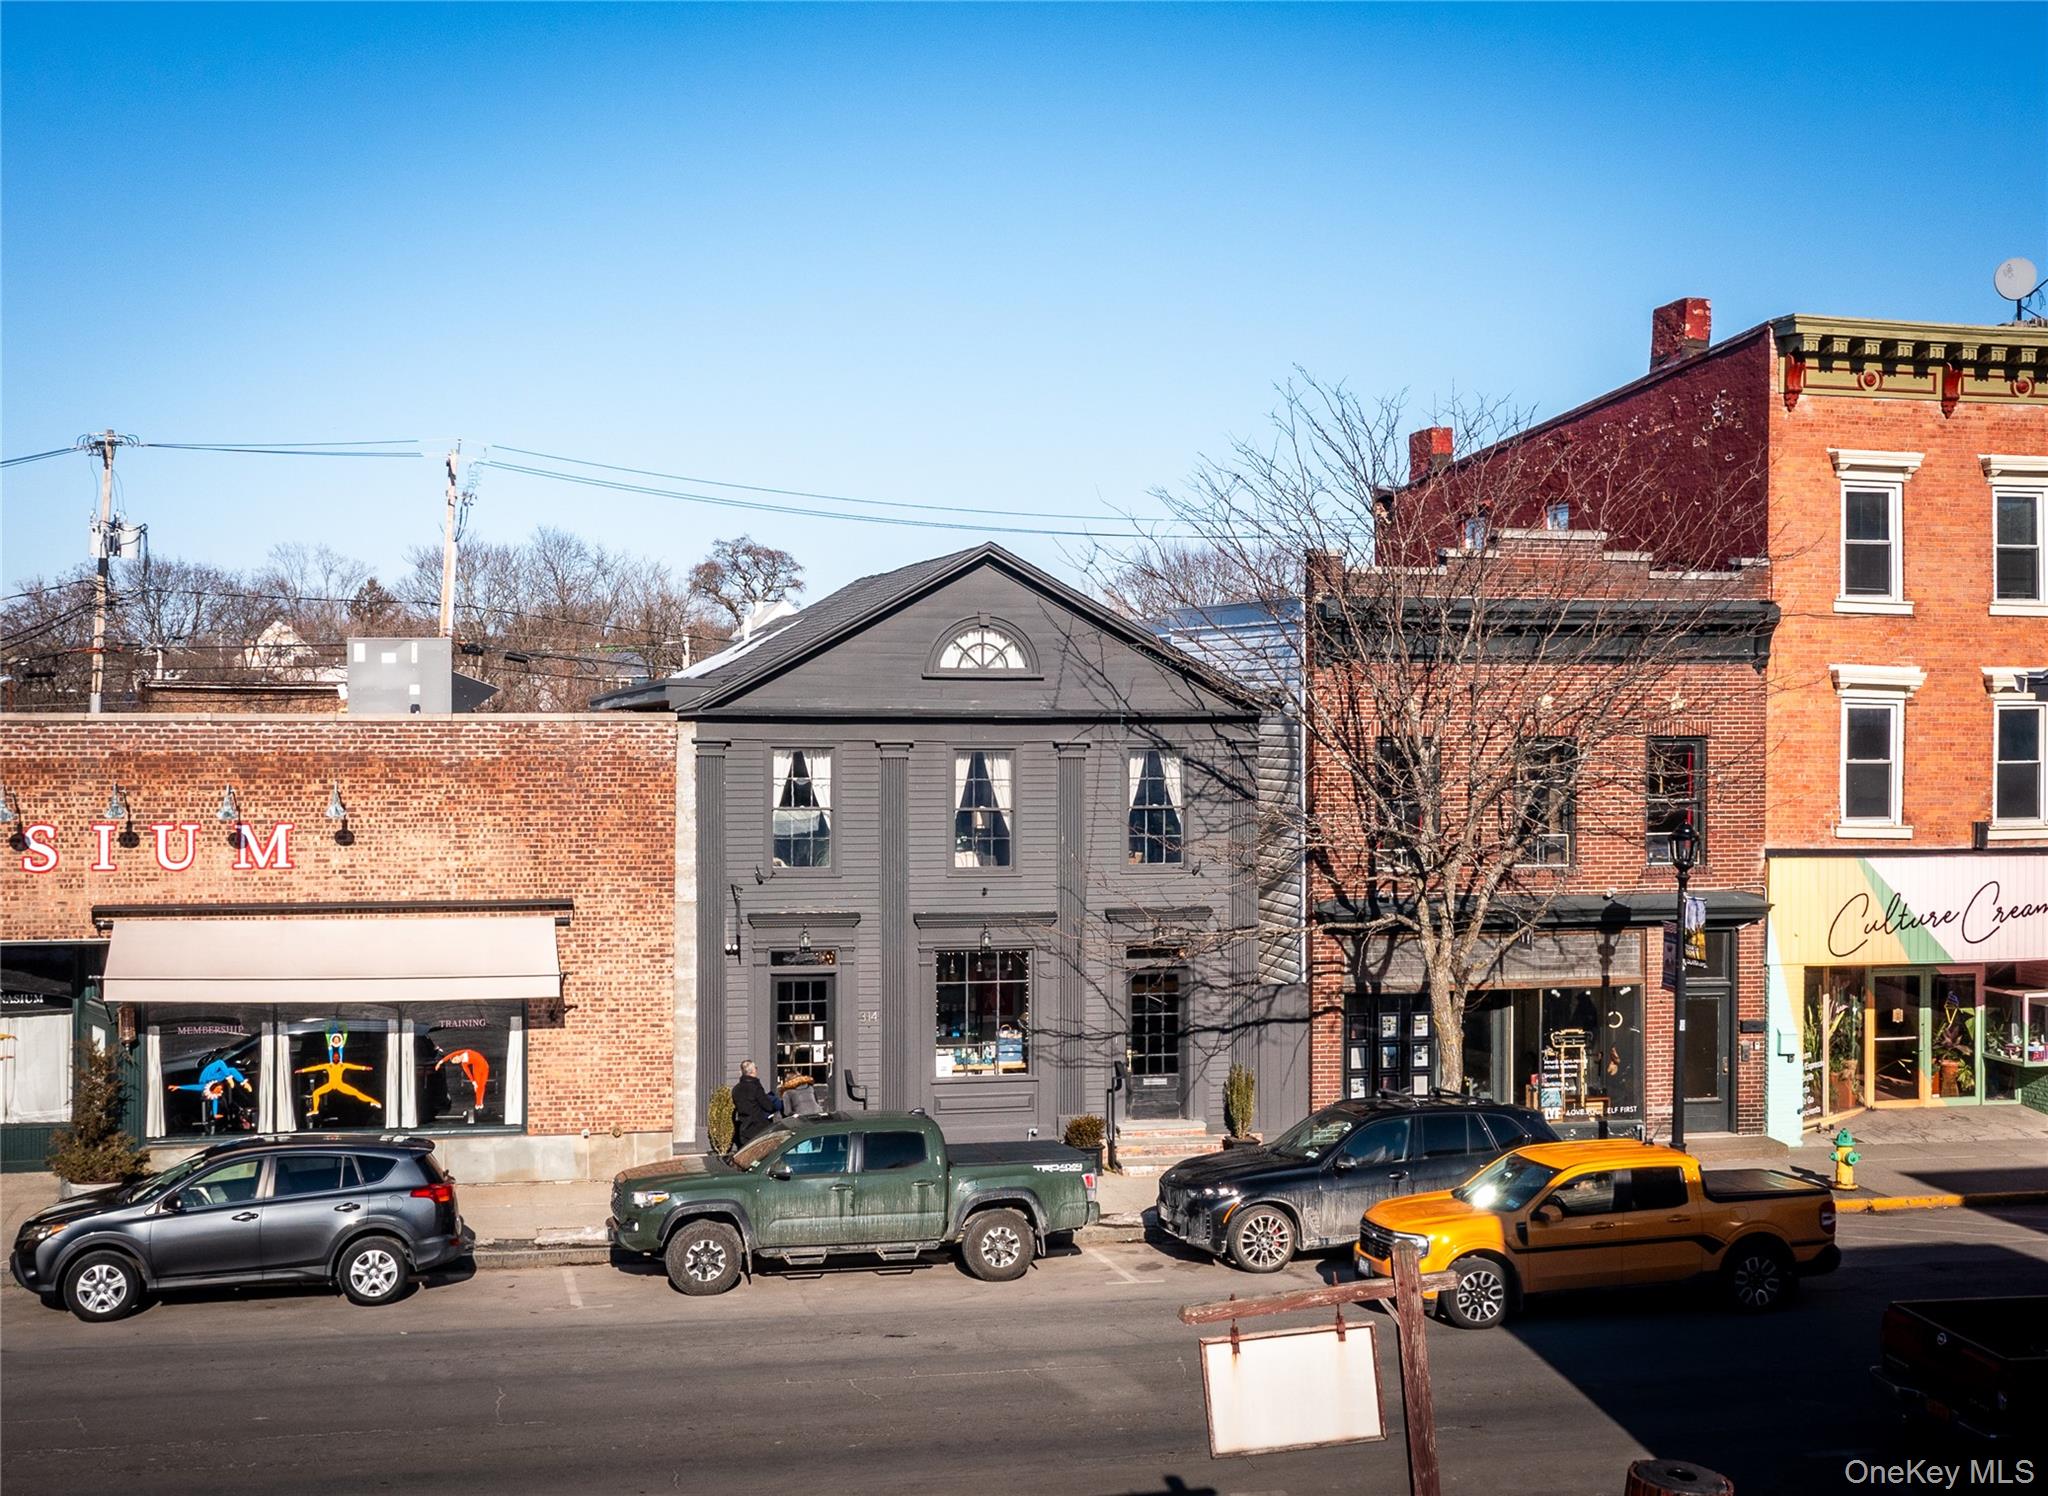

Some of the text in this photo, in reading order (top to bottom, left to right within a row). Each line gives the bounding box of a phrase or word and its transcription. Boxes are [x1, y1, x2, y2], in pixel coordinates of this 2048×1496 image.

[1827, 892, 1960, 958] Culture
[859, 1011, 878, 1022] 314
[439, 1018, 486, 1028] TRAINING
[177, 1024, 245, 1035] MEMBERSHIP
[1619, 1105, 1638, 1113] FIRST
